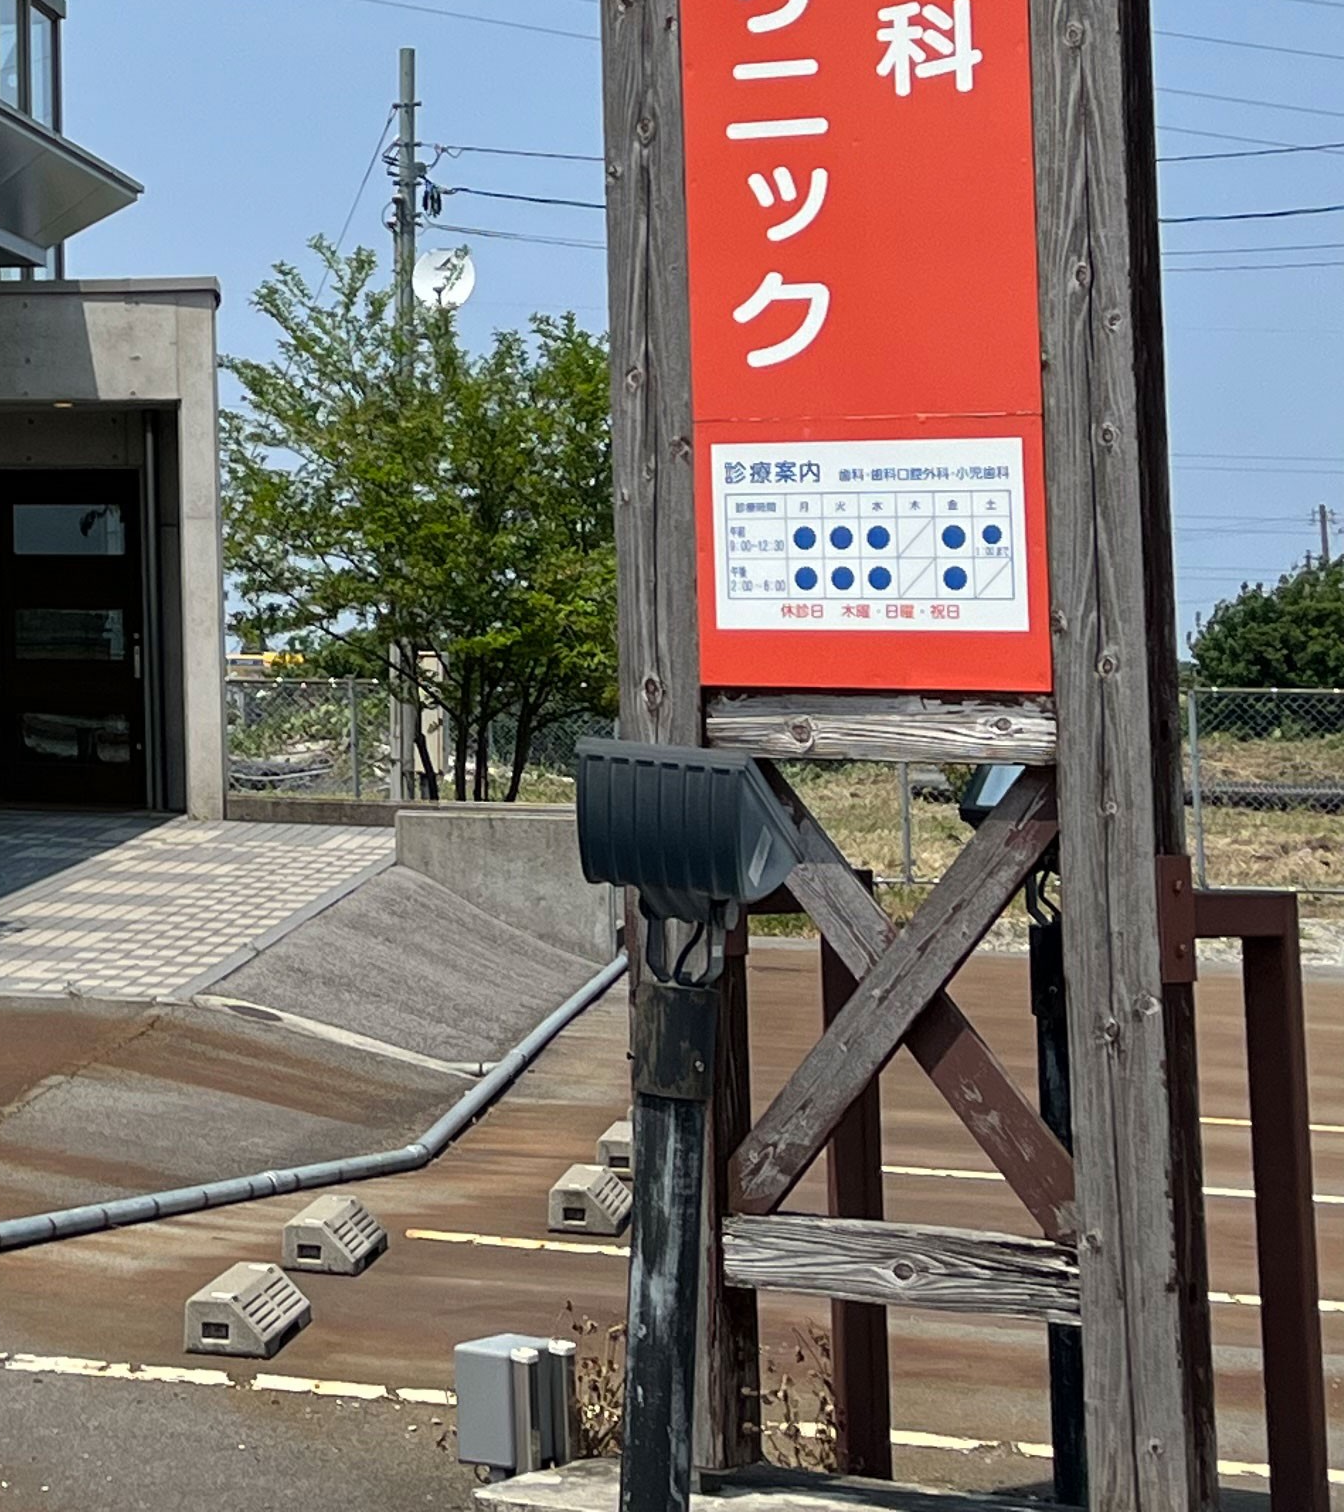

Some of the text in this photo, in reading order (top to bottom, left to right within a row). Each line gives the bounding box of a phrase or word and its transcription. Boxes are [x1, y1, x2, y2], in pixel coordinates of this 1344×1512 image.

[724, 461, 821, 484] 診療案内
[799, 500, 809, 513] 月
[835, 501, 846, 512] 火
[871, 501, 884, 511] 水
[909, 500, 921, 510] 木
[947, 499, 959, 511] 金
[985, 499, 997, 511] 土
[781, 604, 824, 619] 休診日
